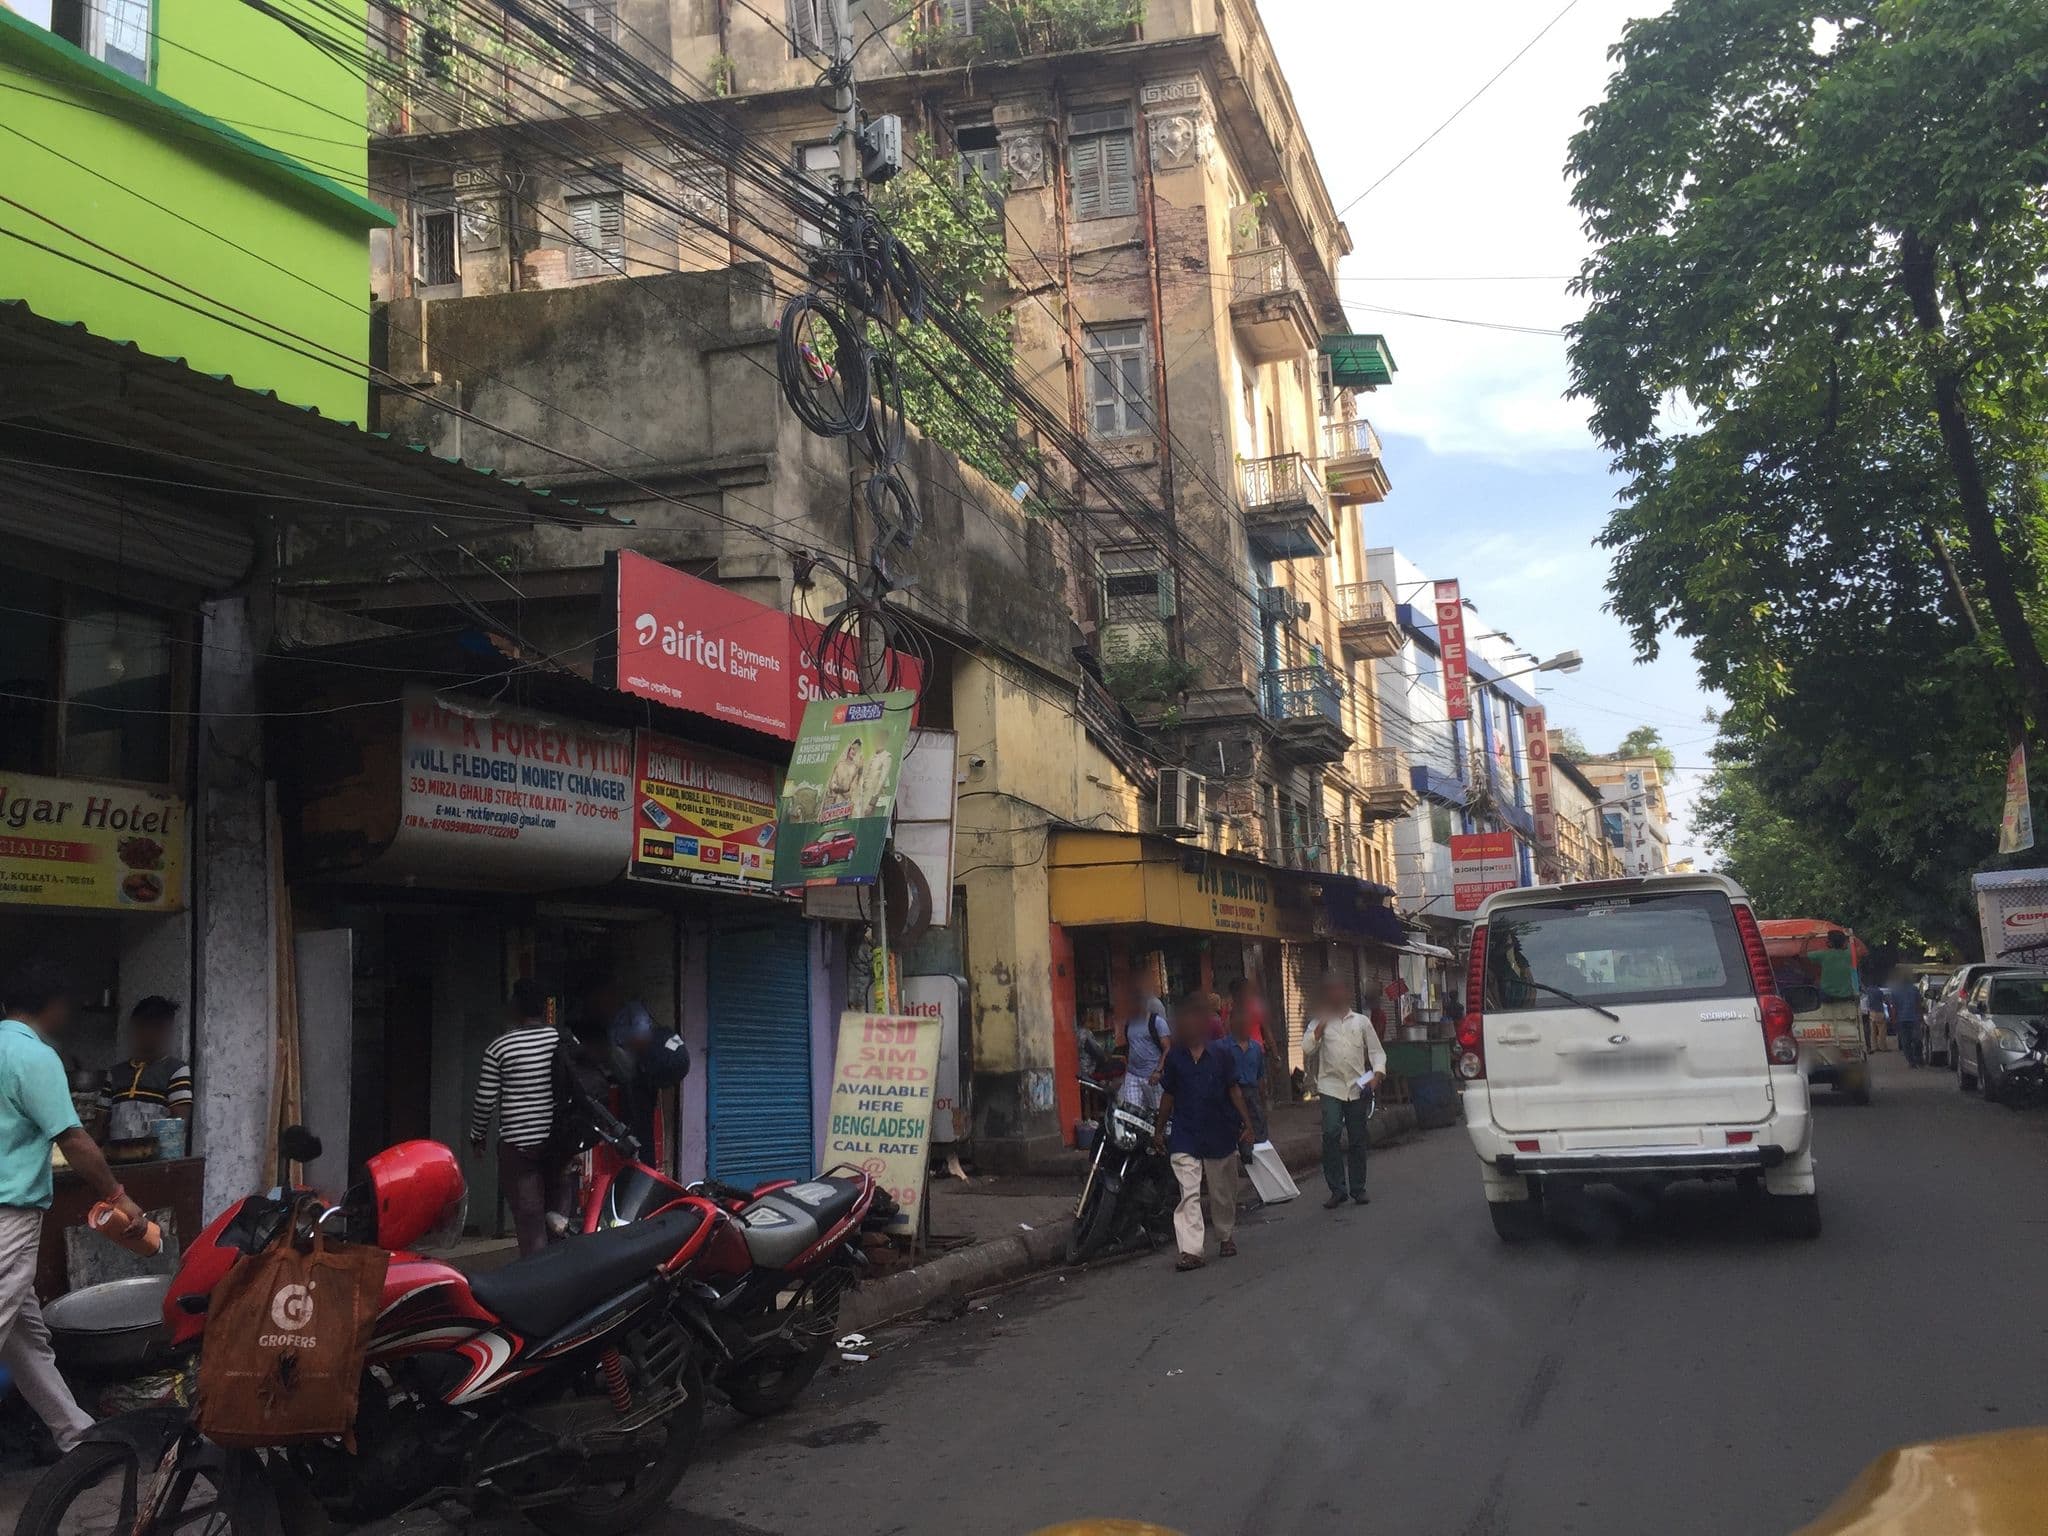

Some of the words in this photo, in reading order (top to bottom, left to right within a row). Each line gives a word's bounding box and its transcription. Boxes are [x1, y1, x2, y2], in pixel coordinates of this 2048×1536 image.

[1437, 585, 1465, 678] HOTEL
[662, 620, 727, 673] airtel
[730, 641, 781, 672] Payments
[730, 659, 757, 682] Bank
[715, 702, 743, 718] Bismillah
[743, 708, 786, 729] Communication
[491, 718, 572, 766] FOREX
[796, 752, 830, 765] BARSAAT
[410, 749, 449, 774] FULL
[453, 754, 517, 784] FLEDGED
[521, 766, 564, 792] MONEY
[567, 774, 626, 802] CHANGER
[647, 751, 704, 789] BISMILLAH
[706, 766, 774, 805] Communication
[1526, 711, 1552, 841] HOTEL
[459, 784, 494, 804] GHALIB
[575, 801, 597, 817] 700
[702, 794, 711, 805] ALL
[711, 795, 727, 808] TYPES
[82, 796, 171, 834] Hotel
[676, 802, 704, 814] MOBILE
[705, 807, 741, 822] REPAIRING
[701, 817, 718, 829] DONE
[718, 820, 734, 831] HERE
[12, 871, 58, 883] KOLKATA
[904, 1001, 942, 1017] airtel
[863, 1016, 918, 1044] ISD
[859, 1046, 917, 1062] SIM
[841, 1064, 928, 1081] CARD
[836, 1083, 929, 1098] AVAILABLE
[858, 1100, 904, 1113] HERE
[832, 1114, 926, 1139] BENGLADESH
[833, 1140, 873, 1154] CALL
[878, 1142, 919, 1155] RATE
[862, 1157, 886, 1178] @
[258, 1334, 317, 1349] GROFERS
